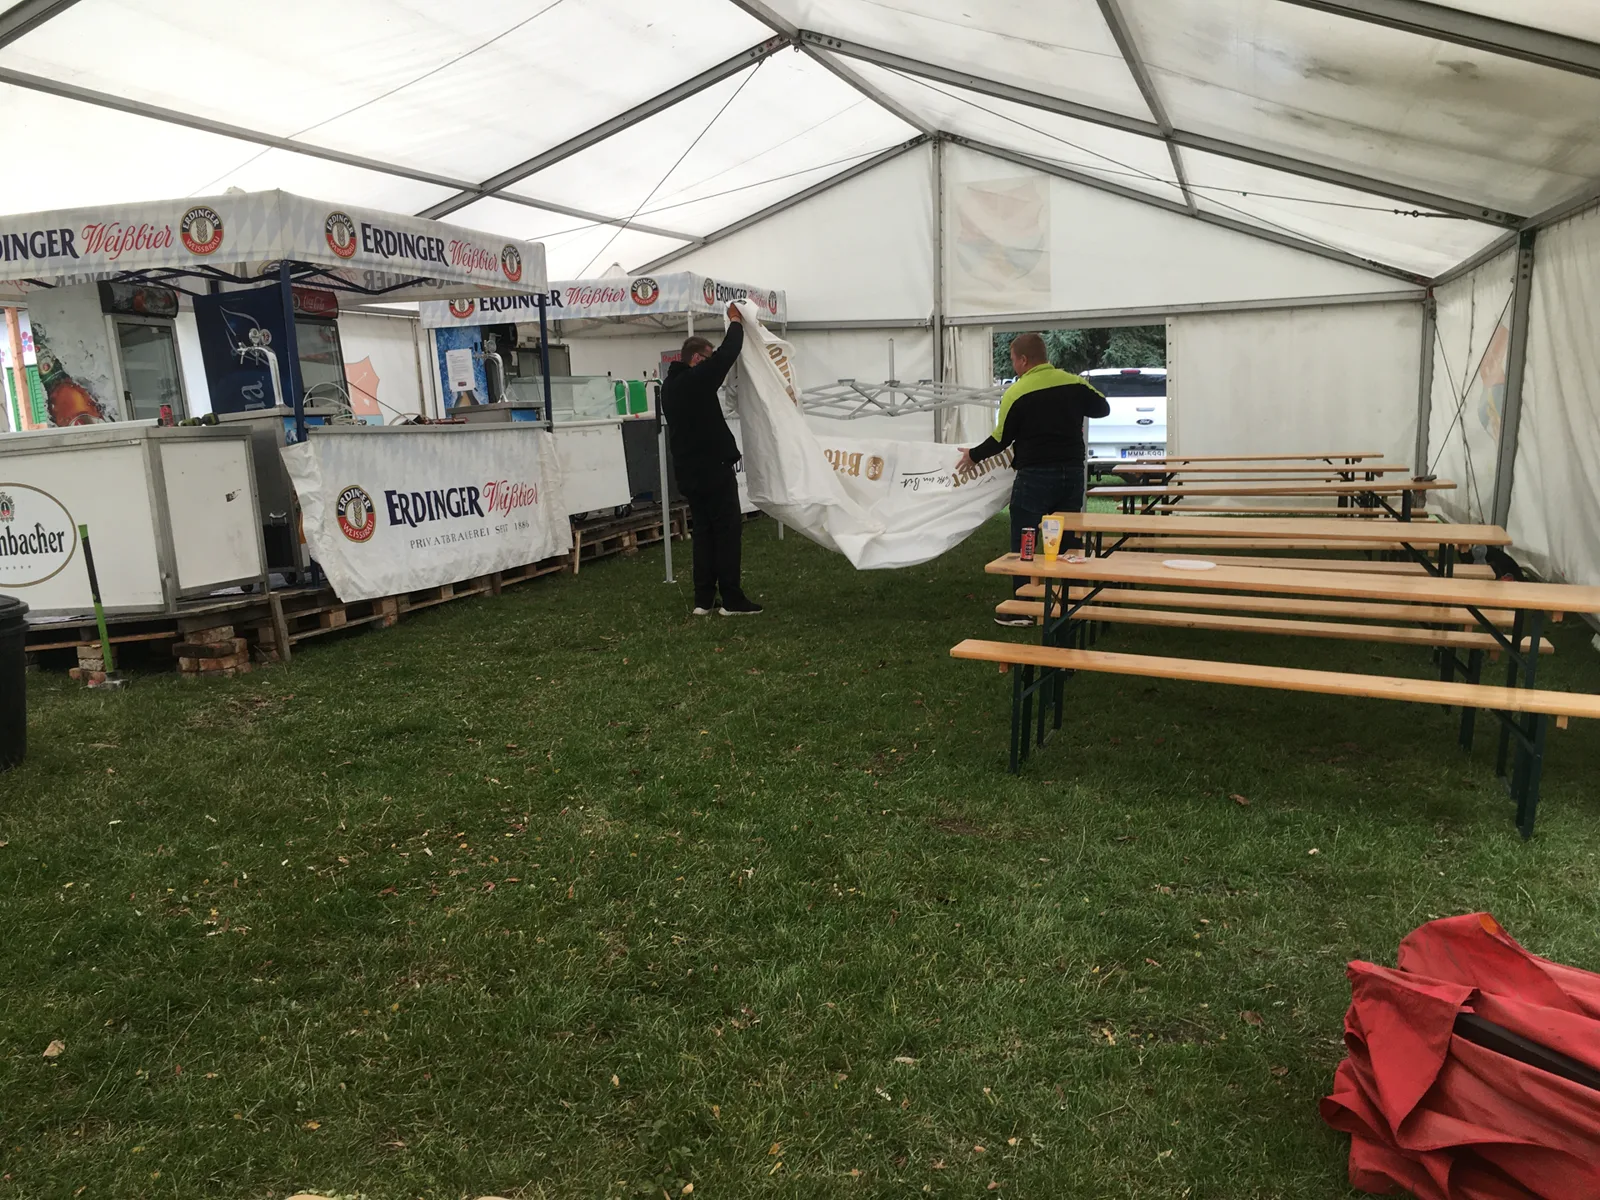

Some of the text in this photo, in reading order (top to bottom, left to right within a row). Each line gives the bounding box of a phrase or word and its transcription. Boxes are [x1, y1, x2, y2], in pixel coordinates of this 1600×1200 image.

[182, 209, 220, 230] ERDINGER
[326, 214, 354, 234] ERDINGER
[0, 222, 174, 262] INGER Weißbier
[361, 222, 500, 274] ERDINGER Weißbier
[565, 285, 627, 309] Weißbier
[338, 488, 372, 512] ERDINER
[384, 486, 485, 528] ERDINGER
